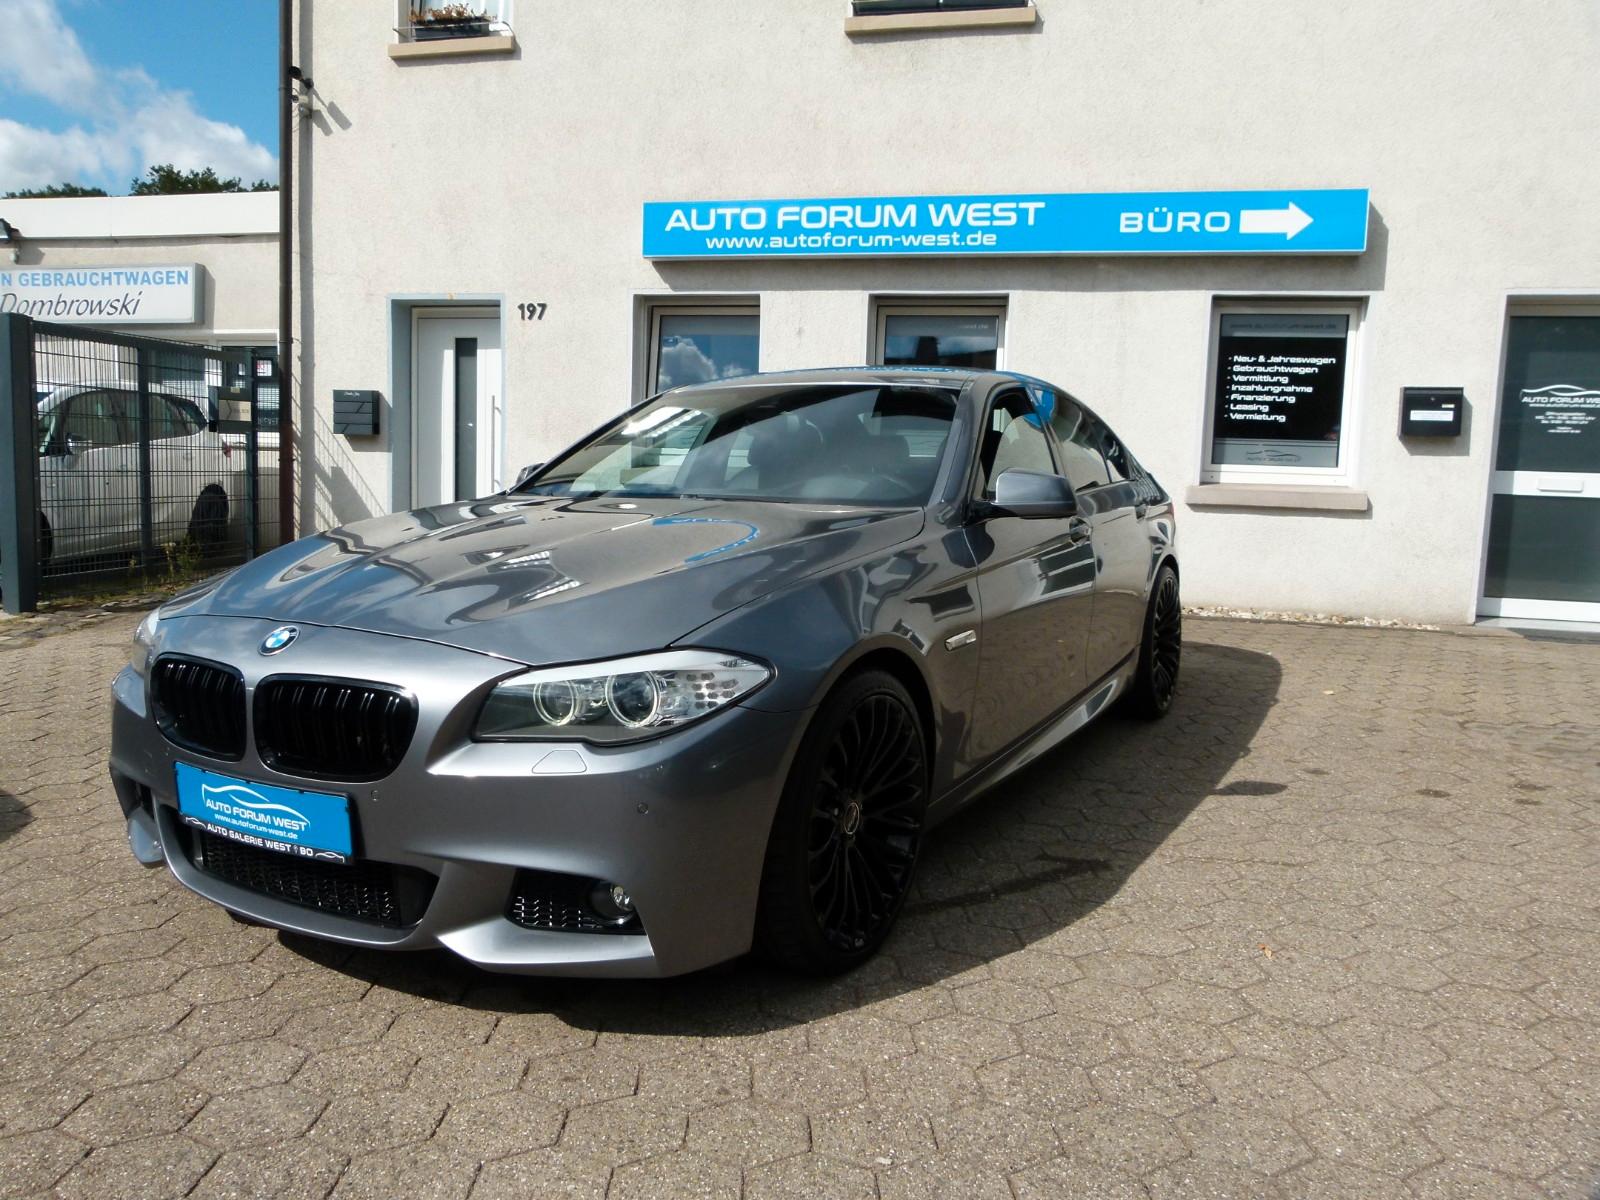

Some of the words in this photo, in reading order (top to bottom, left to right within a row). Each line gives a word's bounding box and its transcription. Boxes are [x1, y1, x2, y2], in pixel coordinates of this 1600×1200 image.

[665, 207, 767, 232] AUTO
[776, 203, 918, 229] FORUM
[928, 201, 1046, 226] WEST
[1119, 206, 1231, 233] BÜRO
[705, 230, 997, 249] www.autoforum-west.de
[19, 270, 189, 287] GEBRAUCHTWAGEN
[0, 290, 143, 316] Dombrowski
[517, 302, 547, 320] 197
[1233, 355, 1257, 363] Neu-
[1258, 355, 1265, 363] &
[1266, 355, 1336, 366] Jahreswagen
[1232, 365, 1319, 375] Gebrauchtwagen
[1232, 374, 1289, 384] Vermittlung
[1231, 384, 1313, 393] Inzahlungnahme
[1230, 393, 1296, 403] Finanzierung
[1230, 403, 1269, 412] Leasing
[1229, 412, 1286, 422] Vermietung
[206, 799, 232, 814] AUTO
[233, 806, 272, 825] FORUM
[272, 816, 308, 832] WEST
[214, 813, 299, 840] www.autoforum-west.de
[207, 823, 228, 837] AUTO
[229, 830, 264, 847] GALERIE
[264, 839, 292, 853] WEST
[299, 846, 314, 857] BO
